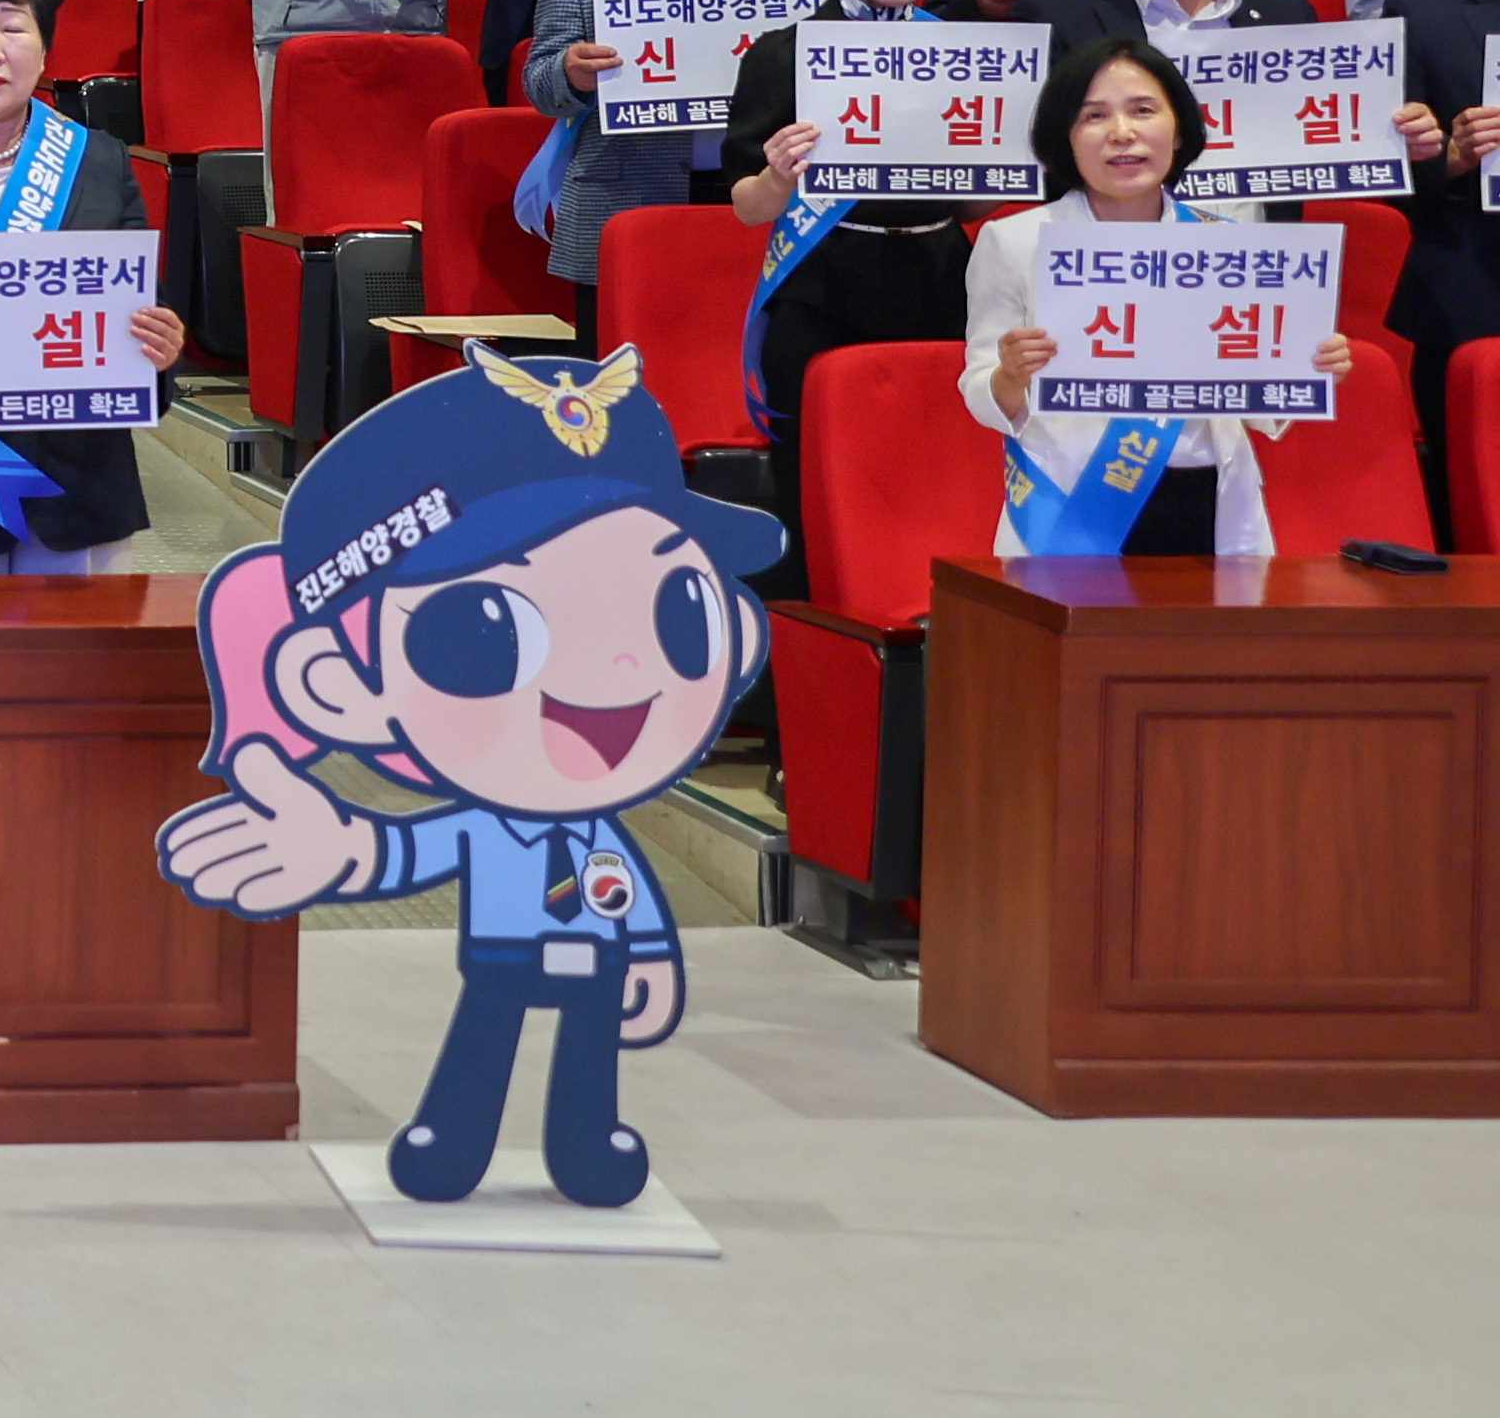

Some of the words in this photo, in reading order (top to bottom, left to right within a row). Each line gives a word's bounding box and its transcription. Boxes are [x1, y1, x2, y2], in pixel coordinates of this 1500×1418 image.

[806, 45, 1039, 83] 진도해양경찰서
[615, 102, 678, 125] 서남해
[838, 94, 881, 145] 신
[940, 95, 1004, 146] 설!
[1294, 93, 1360, 145] 설!
[813, 167, 878, 190] 서남해
[887, 168, 973, 191] 골든타임
[985, 168, 1029, 191] 확보
[1173, 171, 1238, 197] 서남해
[1246, 166, 1337, 193] 골든타임
[1348, 164, 1395, 187] 확보
[1048, 248, 1329, 289] 진도해양경찰서
[32, 310, 106, 369] 설!
[1083, 303, 1136, 359] 신
[1209, 303, 1285, 360] 설!
[89, 392, 140, 418] 확보
[1050, 382, 1131, 409] 서남해
[1144, 383, 1247, 409] 골든타임
[1262, 383, 1315, 409] 확보
[1105, 430, 1158, 494] 신설
[294, 487, 451, 615] 진도해양경찰
